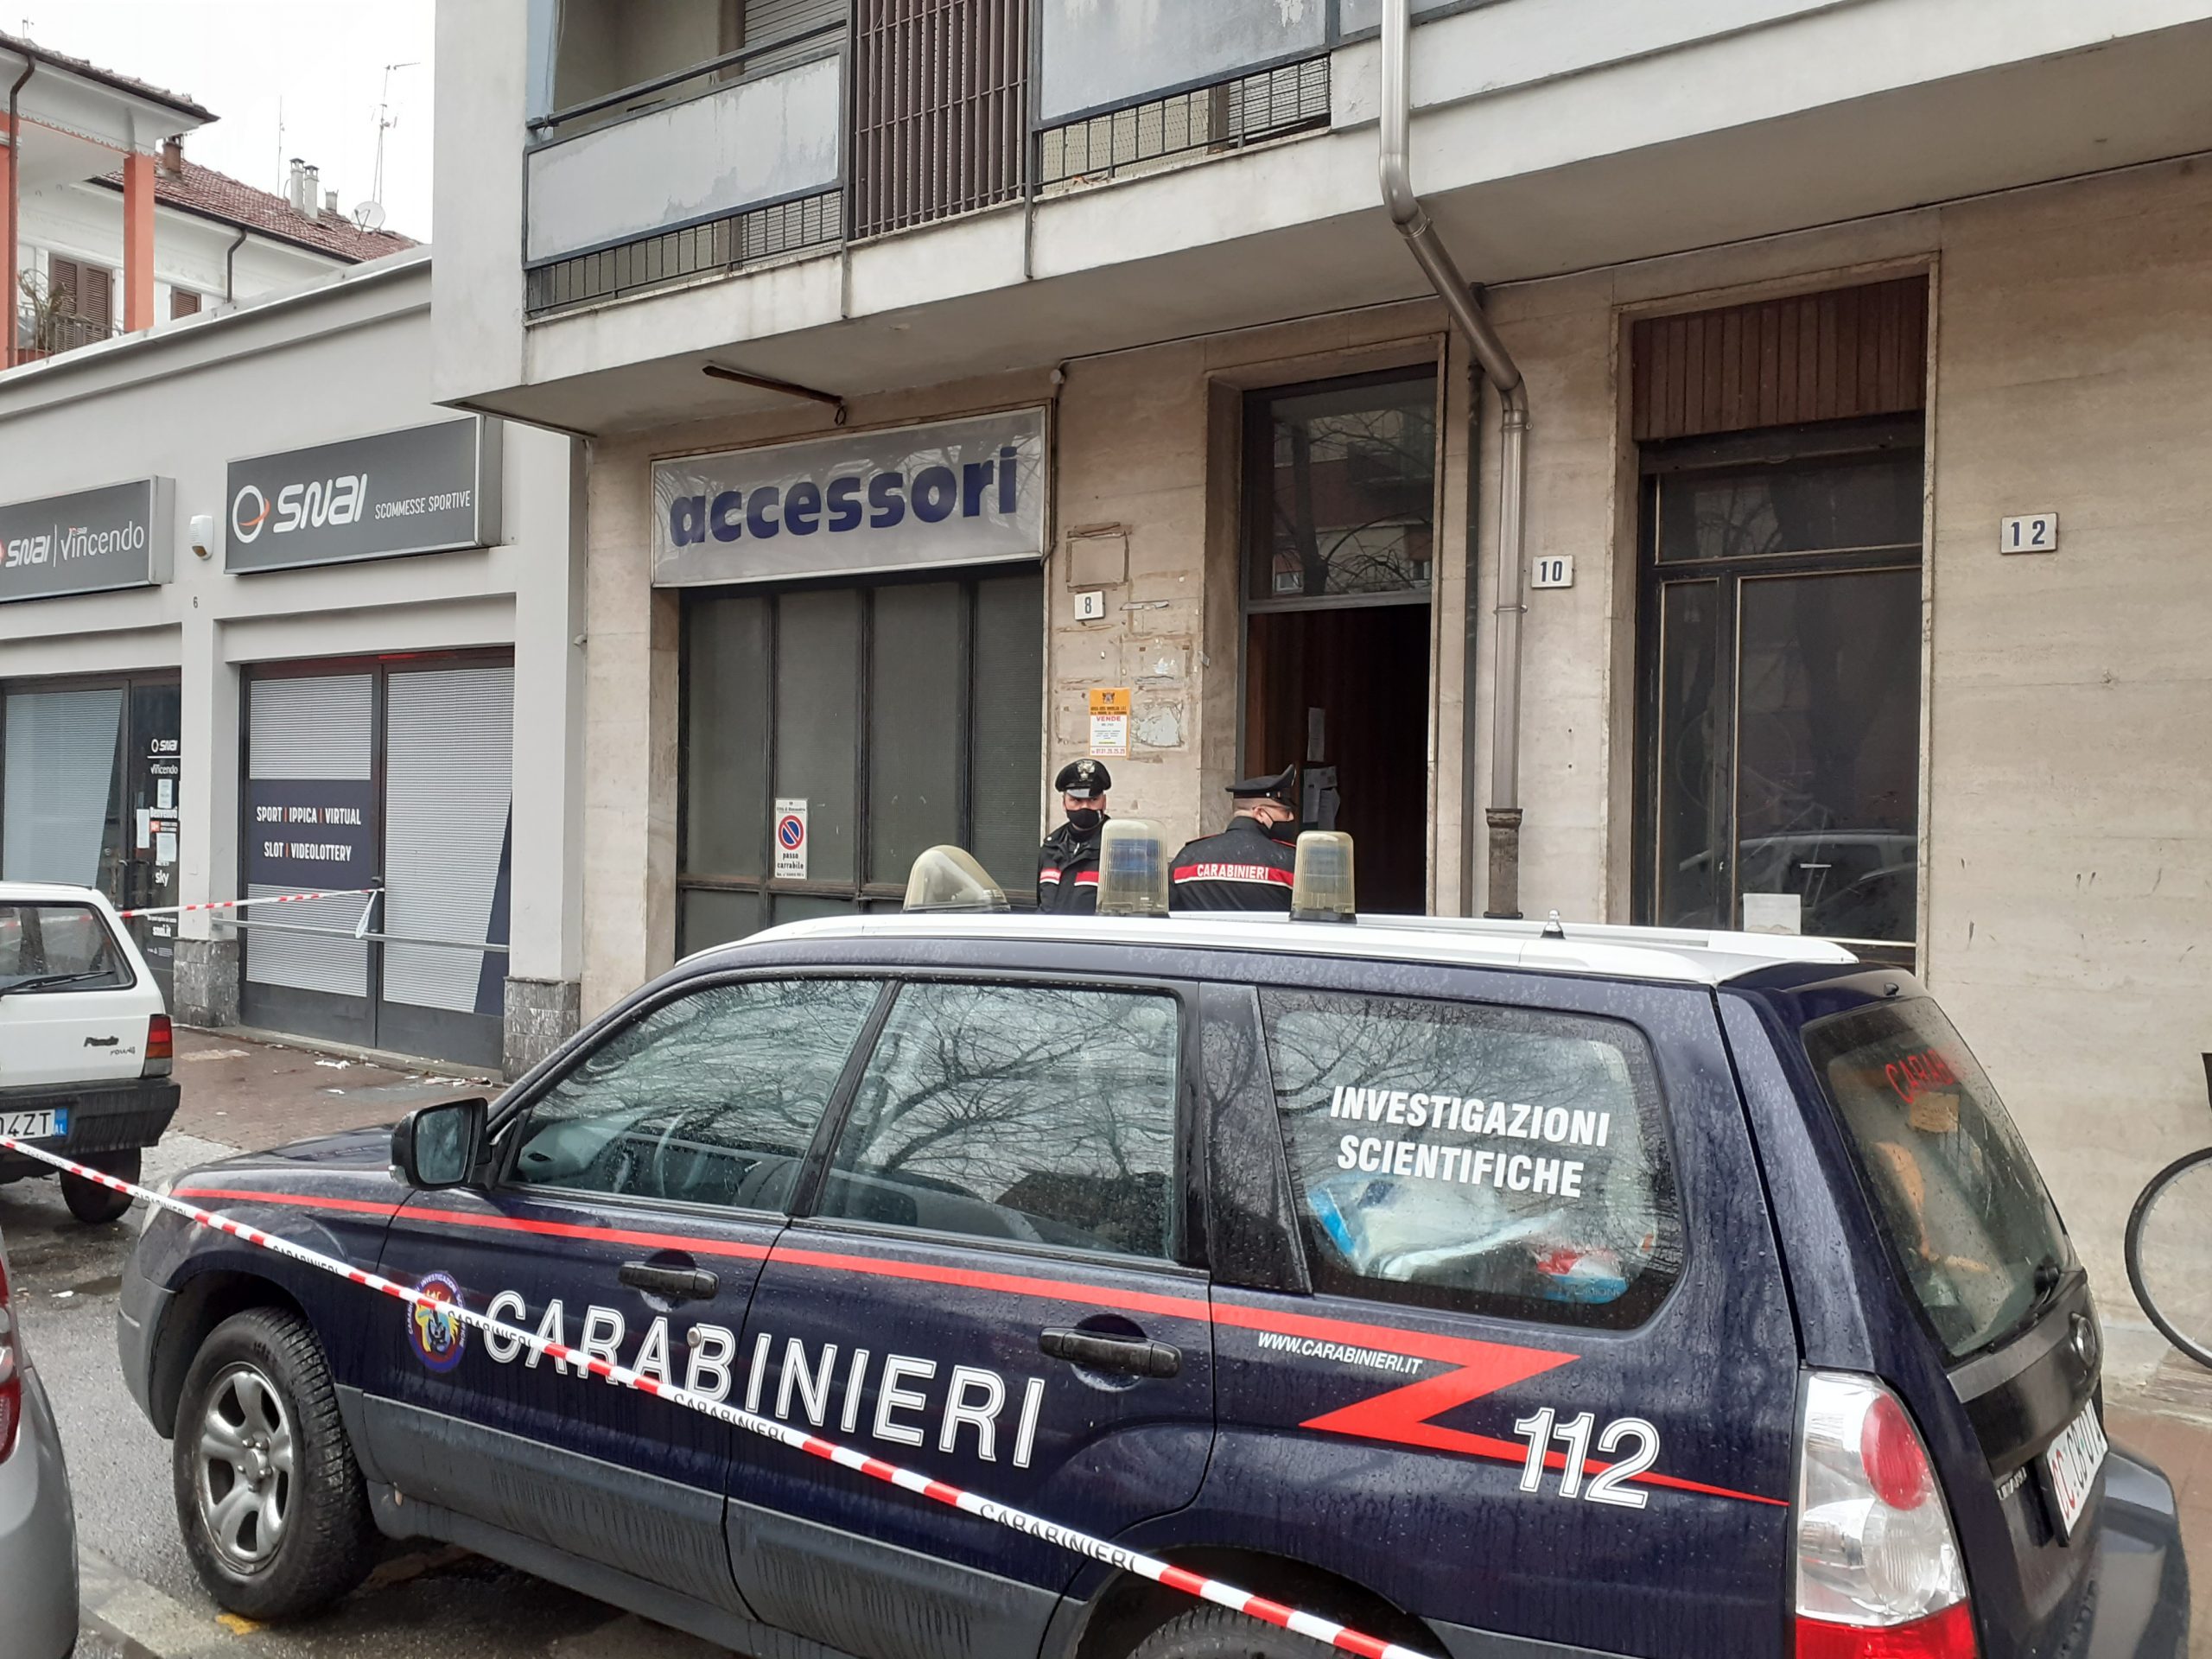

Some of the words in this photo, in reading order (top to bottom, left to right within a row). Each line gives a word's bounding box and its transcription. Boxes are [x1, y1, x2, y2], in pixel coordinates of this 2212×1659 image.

[374, 497, 427, 520] SCOMMESSE
[428, 489, 472, 512] SPORTIVE
[668, 446, 1018, 548] accessori
[2011, 519, 2045, 547] 12
[1540, 560, 1563, 583] 10
[193, 595, 199, 609] 6
[1084, 595, 1092, 614] 8
[256, 806, 283, 823] SPORT
[289, 806, 318, 823] IPPICA
[324, 807, 362, 825] VIRTUAL
[264, 841, 284, 858] SLOT
[290, 842, 353, 862] VIDEOLOTTERY
[782, 852, 799, 861] passo
[777, 861, 804, 870] carrabile
[1196, 863, 1269, 880] CARABINIERI
[155, 869, 169, 887] sky
[1330, 1084, 1611, 1147] INVESTIGAZIONI
[54, 1124, 67, 1135] AL
[1338, 1134, 1585, 1198] SCIENTIFICHE
[1257, 1332, 1423, 1375] WWW.CARABINIERI.IT
[482, 1288, 1046, 1470] CARABINIERI
[1513, 1407, 1661, 1510] 112
